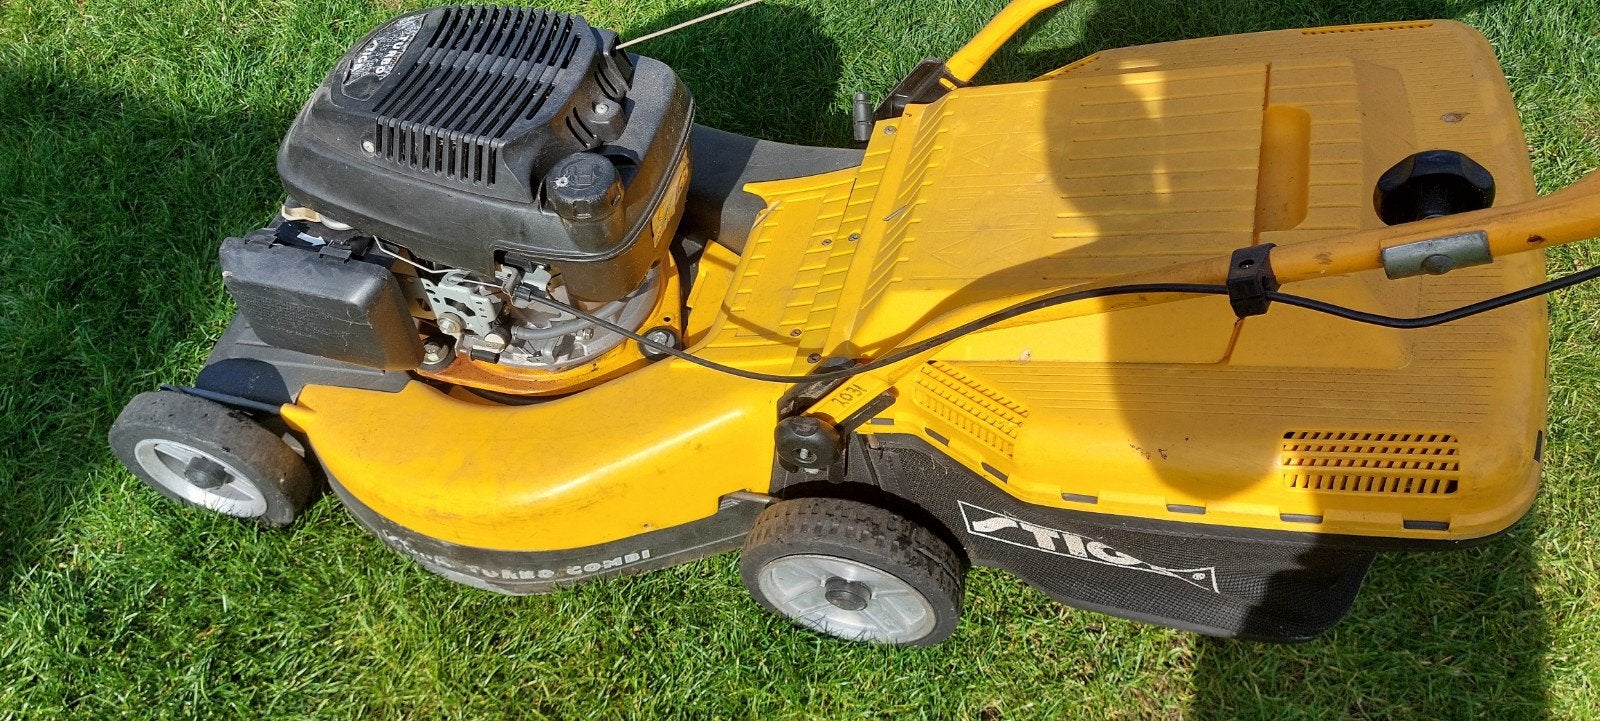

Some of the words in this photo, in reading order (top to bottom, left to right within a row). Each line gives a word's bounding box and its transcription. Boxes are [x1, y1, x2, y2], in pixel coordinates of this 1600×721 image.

[375, 35, 410, 75] TURBO
[971, 516, 1143, 566] STIG
[566, 549, 651, 576] COMBI
